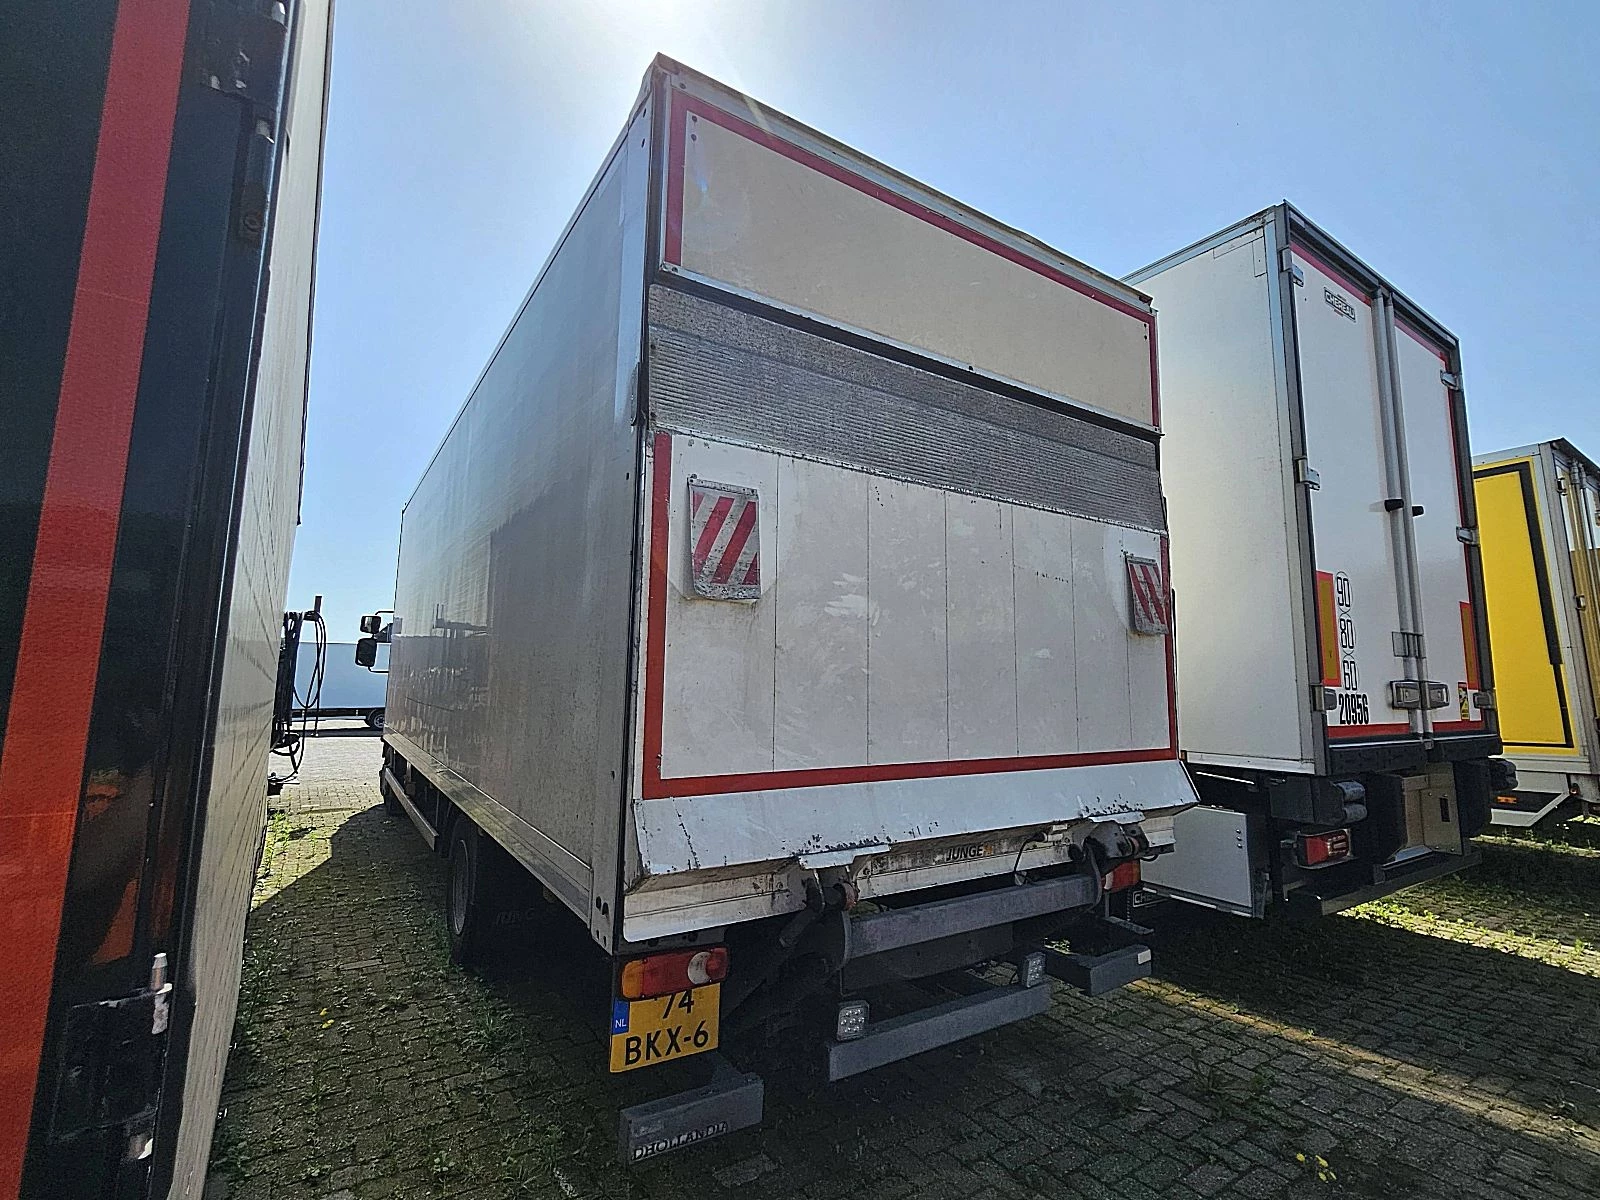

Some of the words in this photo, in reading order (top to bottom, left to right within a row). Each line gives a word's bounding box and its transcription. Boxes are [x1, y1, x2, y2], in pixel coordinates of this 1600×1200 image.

[1337, 576, 1350, 608] 90
[1340, 618, 1354, 650] 80
[1343, 659, 1357, 691] 60
[1339, 693, 1369, 725] 20956
[946, 844, 984, 861] JUNGE
[615, 1018, 627, 1028] NL
[625, 1020, 709, 1066] BKX-6
